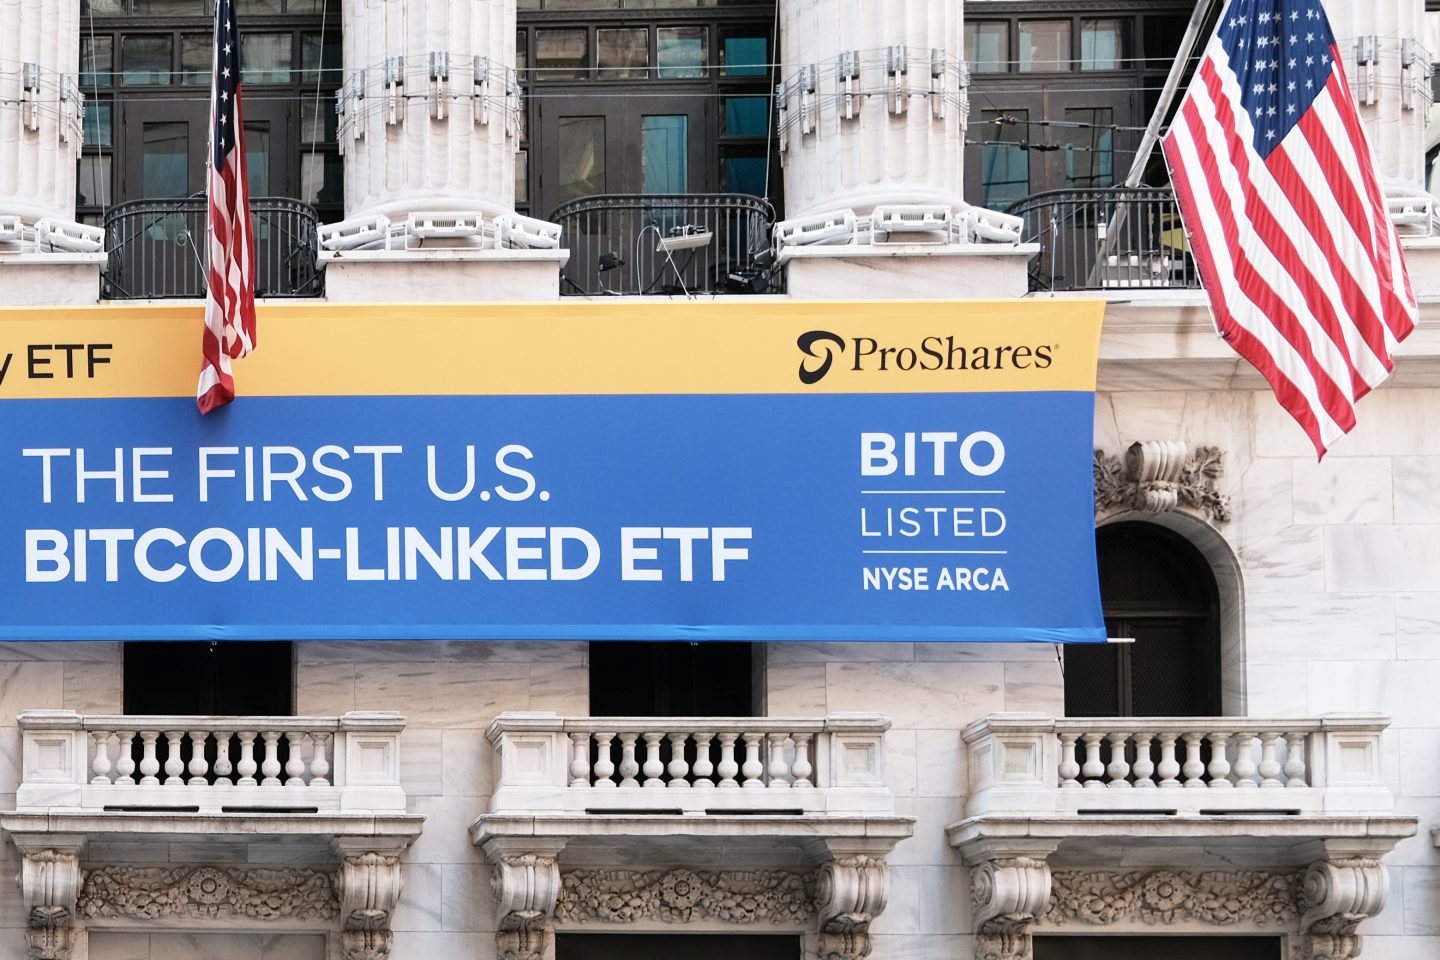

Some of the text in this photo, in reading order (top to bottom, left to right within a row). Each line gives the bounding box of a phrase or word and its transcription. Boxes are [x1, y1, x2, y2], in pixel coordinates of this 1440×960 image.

[27, 344, 113, 379] ETF
[22, 445, 550, 503] THE FIRST U.S.
[860, 430, 1005, 477] BITO
[861, 507, 1007, 537] LISTED
[25, 526, 753, 583] BITCOIN-LINKED ETF
[862, 566, 1010, 592] NYSE ARCA
